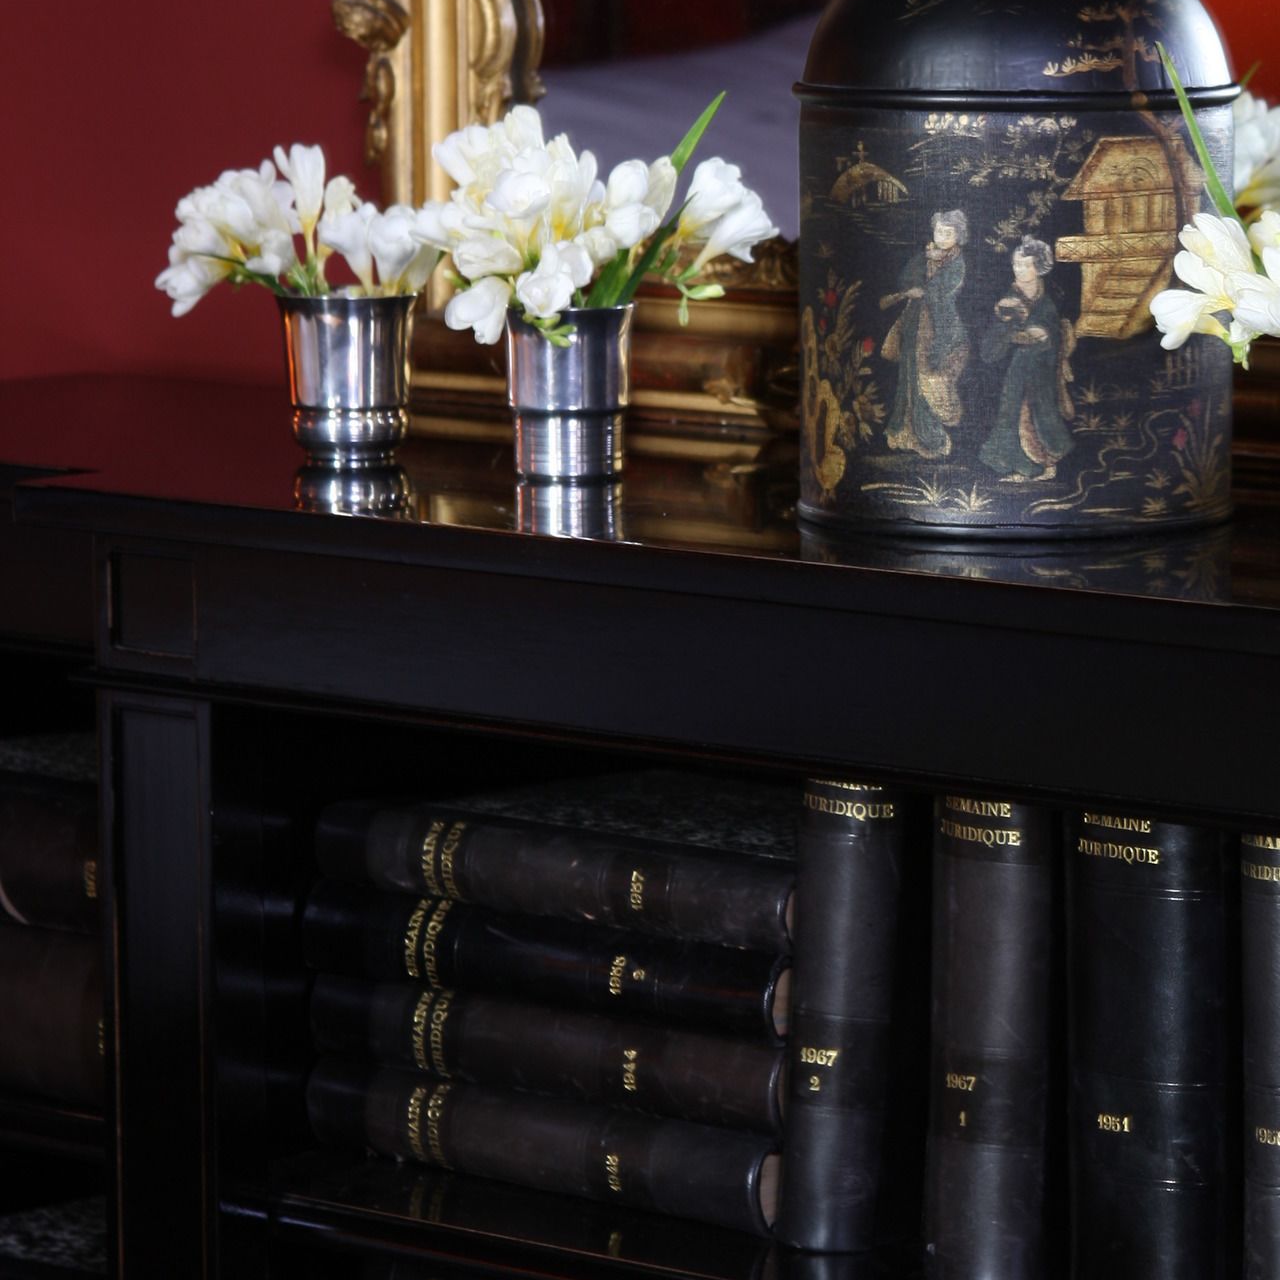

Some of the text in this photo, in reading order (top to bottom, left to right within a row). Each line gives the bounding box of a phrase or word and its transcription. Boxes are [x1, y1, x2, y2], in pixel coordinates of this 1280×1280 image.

[803, 792, 895, 822] JURIDIQUE
[945, 794, 1013, 819] SEMAINE
[940, 818, 1022, 849] JURIDIQUE
[1083, 811, 1152, 834] SEMAINE
[1077, 837, 1161, 865] JURIDIQUE
[404, 898, 433, 978] SEMAINE
[412, 991, 435, 1071] SEMAINE
[800, 1046, 839, 1068] 1967
[622, 1048, 639, 1094] 1944
[809, 1074, 821, 1093] 2
[944, 1071, 977, 1093] 1967
[959, 1110, 968, 1128] 1
[1097, 1112, 1131, 1134] 1951
